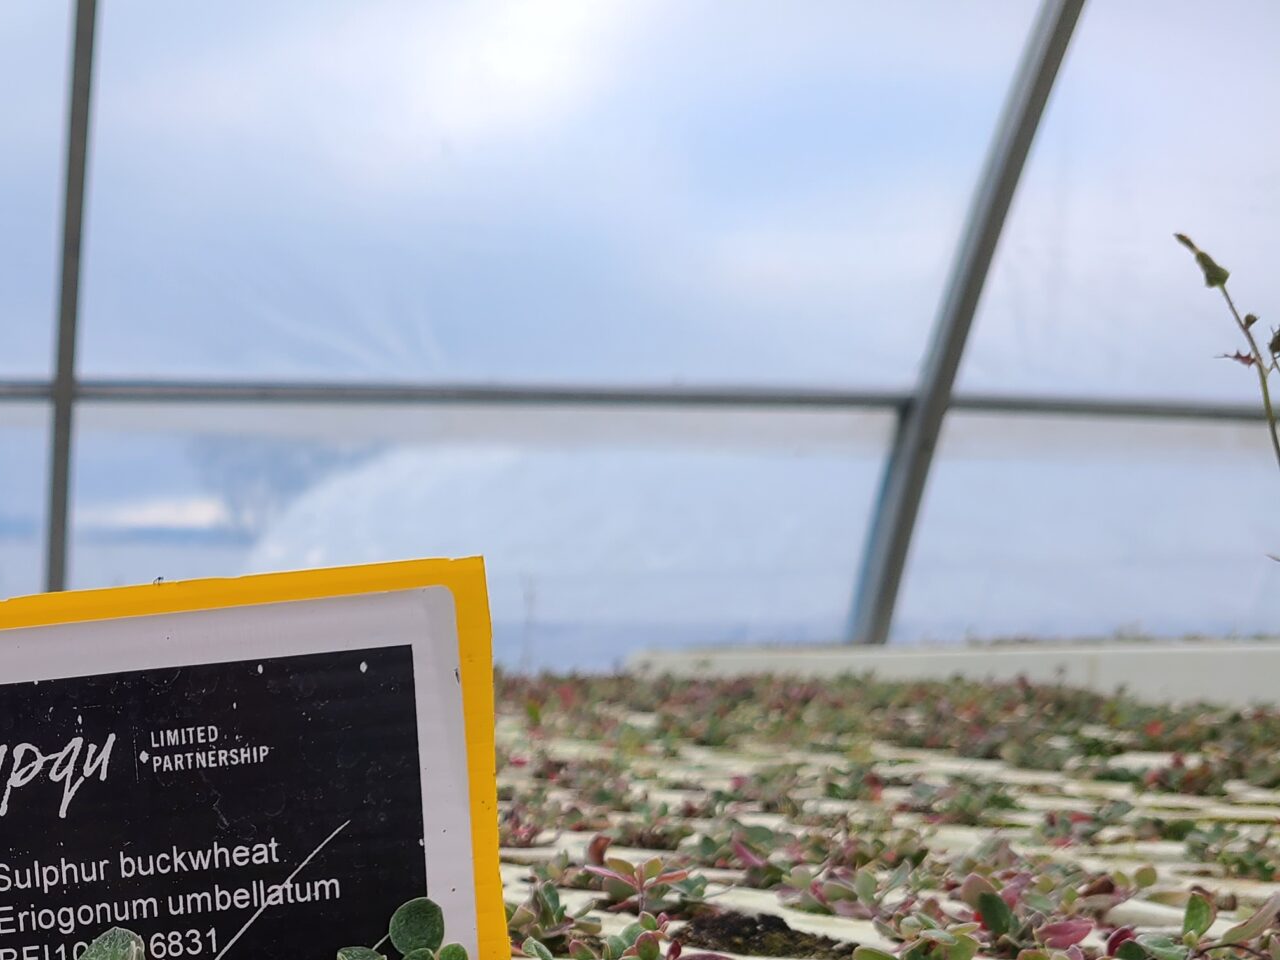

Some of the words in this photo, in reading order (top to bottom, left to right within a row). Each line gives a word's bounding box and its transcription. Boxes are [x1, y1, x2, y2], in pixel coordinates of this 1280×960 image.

[151, 725, 218, 749] LIMITED
[152, 746, 270, 772] PARTNERSHIP
[119, 839, 279, 878] buckwheat
[167, 877, 341, 917] umbellatum
